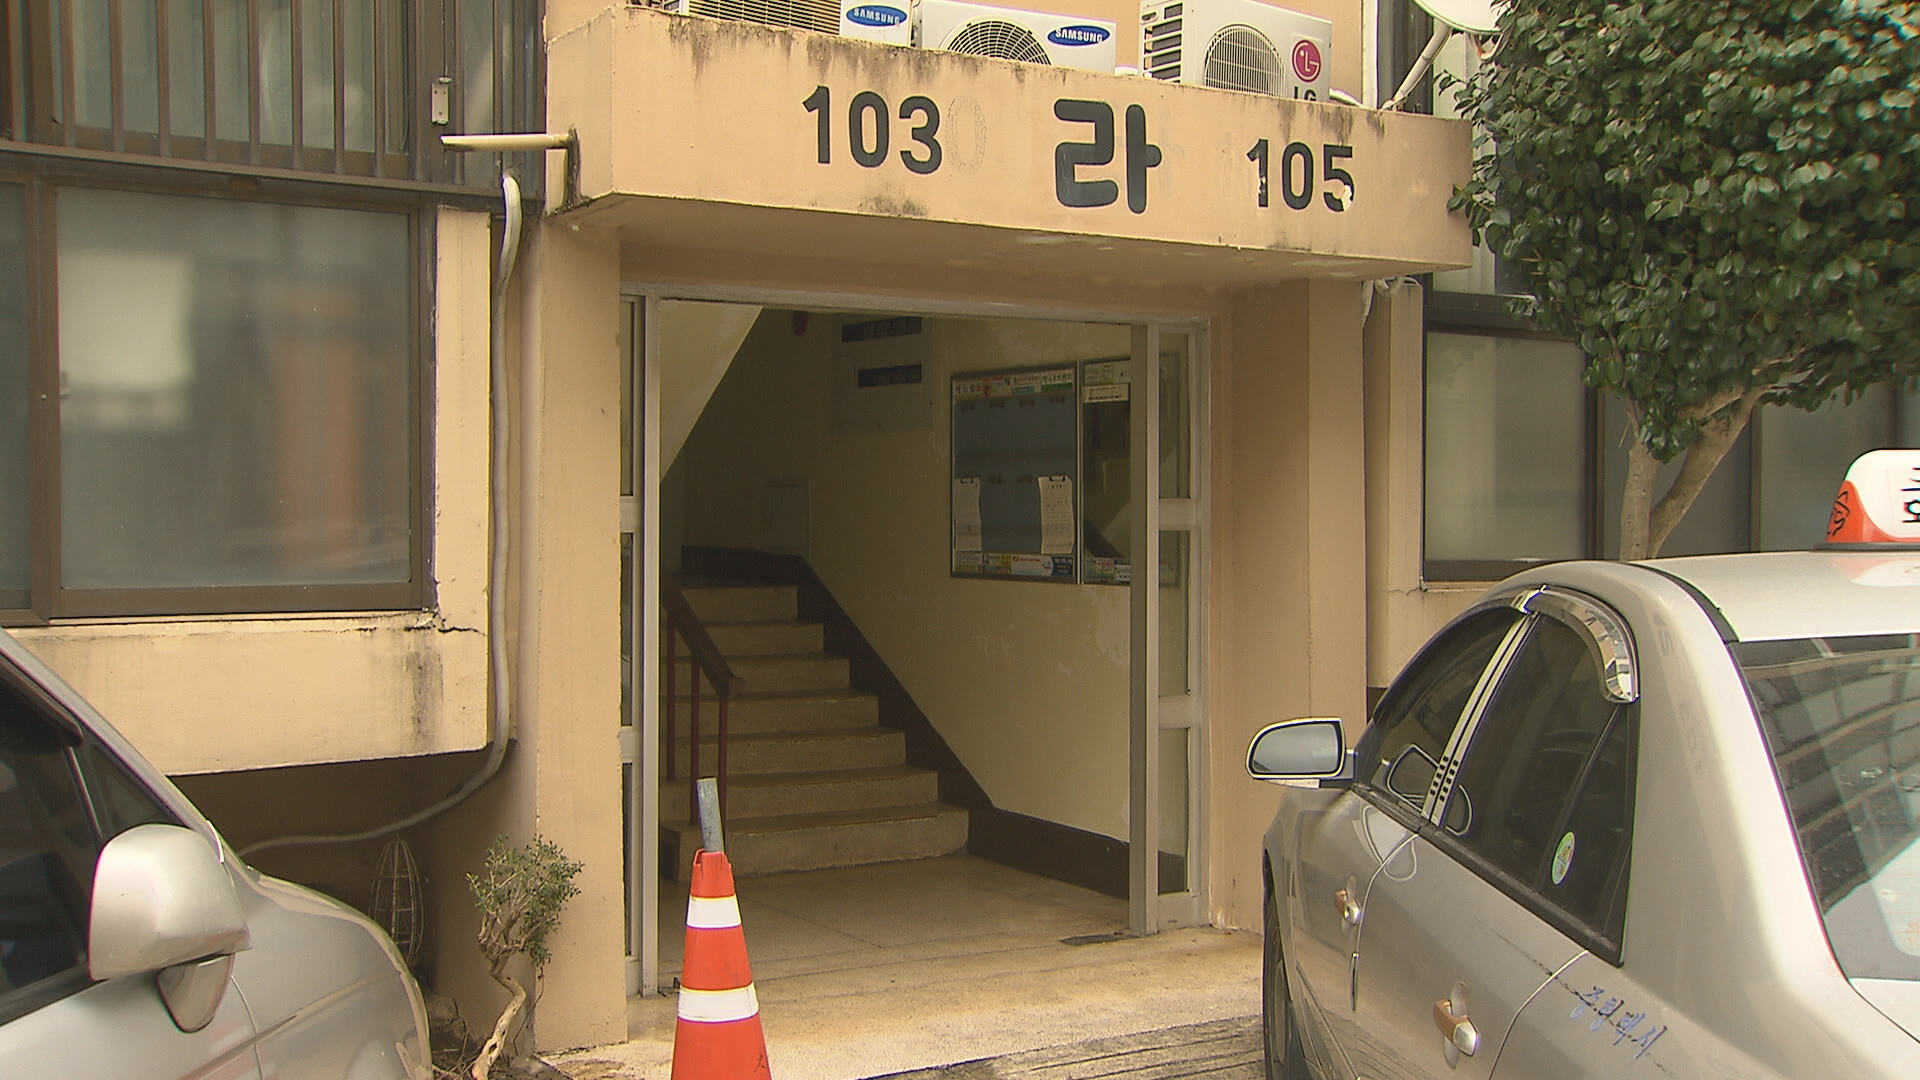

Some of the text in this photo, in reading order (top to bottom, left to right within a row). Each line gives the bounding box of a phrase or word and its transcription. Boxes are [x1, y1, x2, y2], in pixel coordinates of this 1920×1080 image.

[852, 8, 901, 26] SAMSUNG
[1055, 28, 1104, 44] SAMSUNG
[802, 86, 943, 174] 103
[1054, 99, 1162, 214] 라
[1247, 139, 1355, 212] 105
